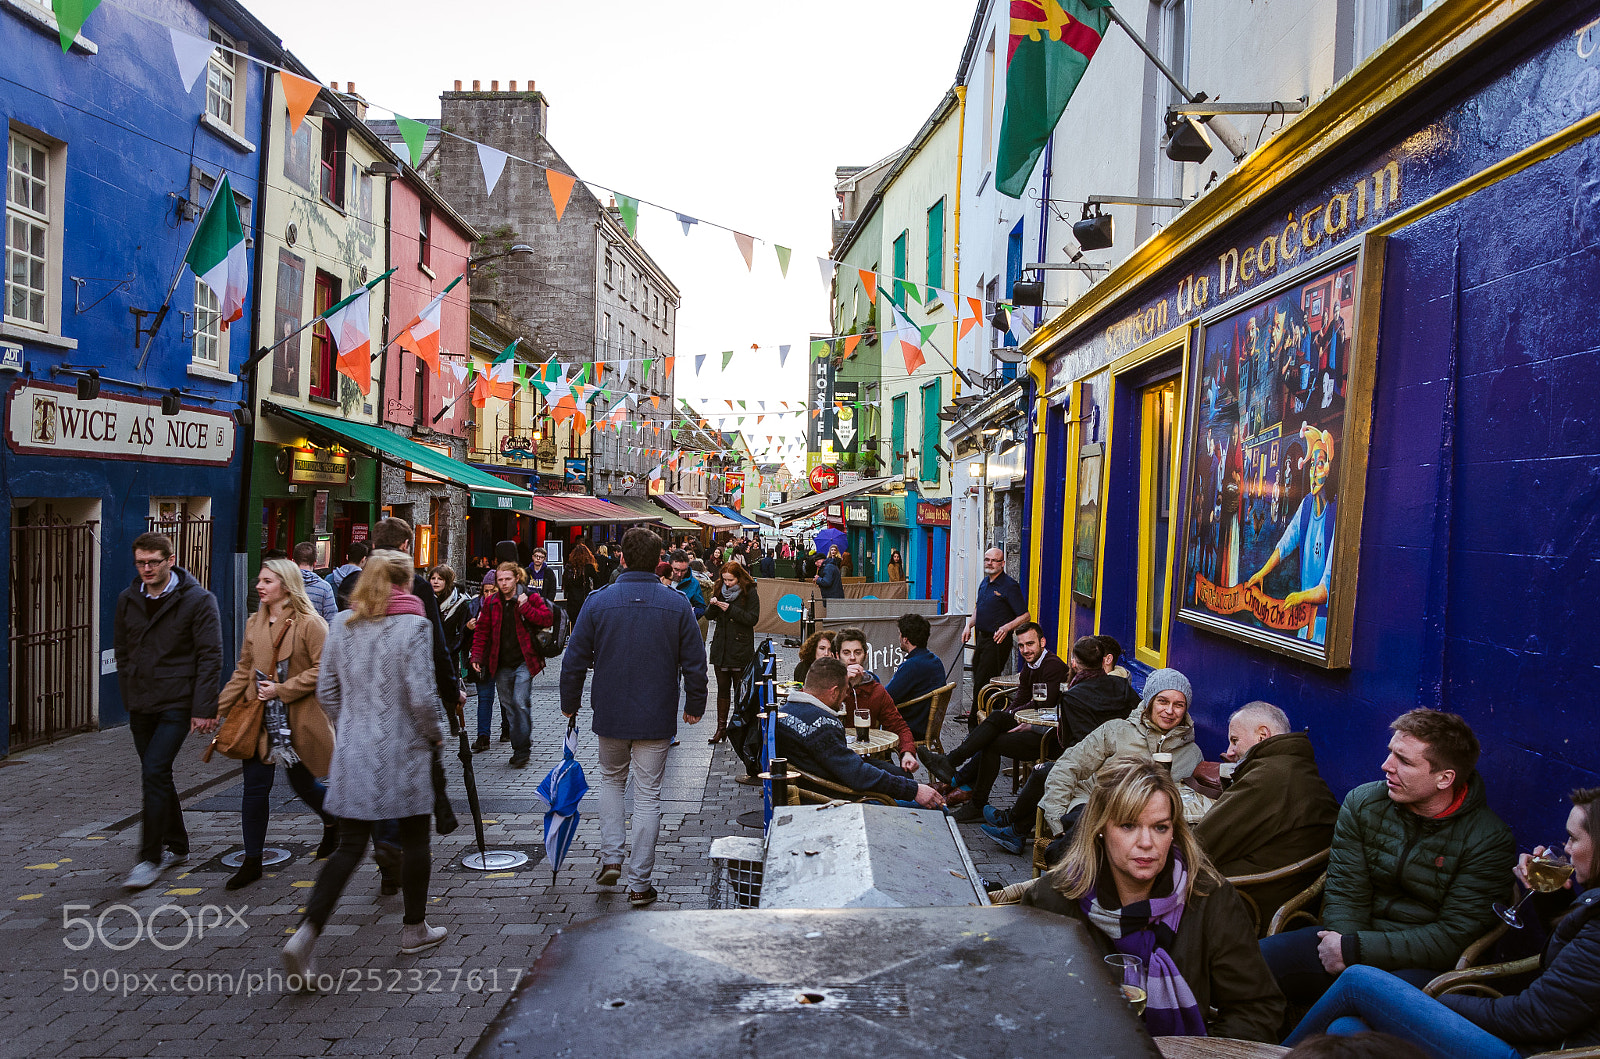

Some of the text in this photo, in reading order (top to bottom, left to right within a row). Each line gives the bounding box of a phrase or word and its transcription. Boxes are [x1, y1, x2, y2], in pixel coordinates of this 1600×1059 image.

[3, 348, 20, 362] ADT
[34, 399, 225, 449] TWICE AS NICE 5
